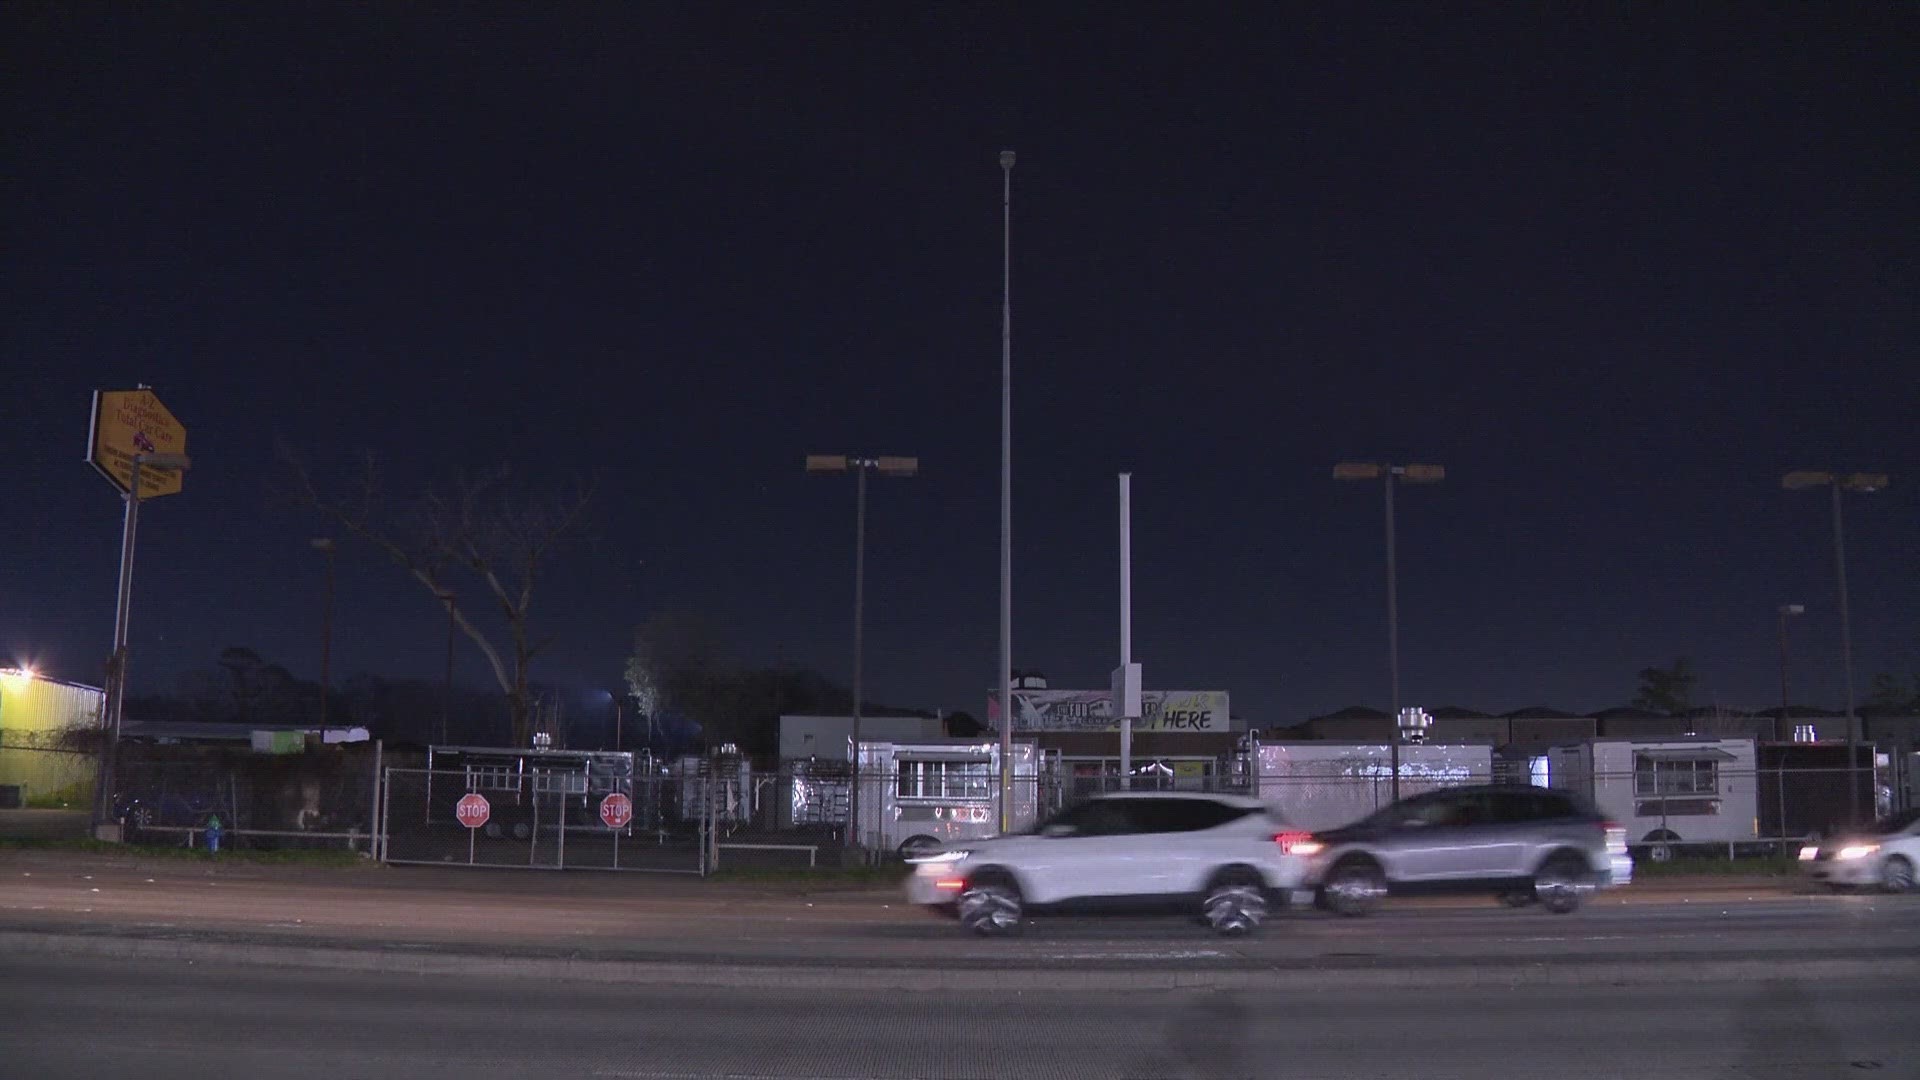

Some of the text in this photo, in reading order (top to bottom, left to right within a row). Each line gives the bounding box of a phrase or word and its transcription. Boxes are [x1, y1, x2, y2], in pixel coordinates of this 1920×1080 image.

[1163, 710, 1212, 731] HERE
[459, 804, 487, 818] STOP
[603, 804, 629, 817] STOP
